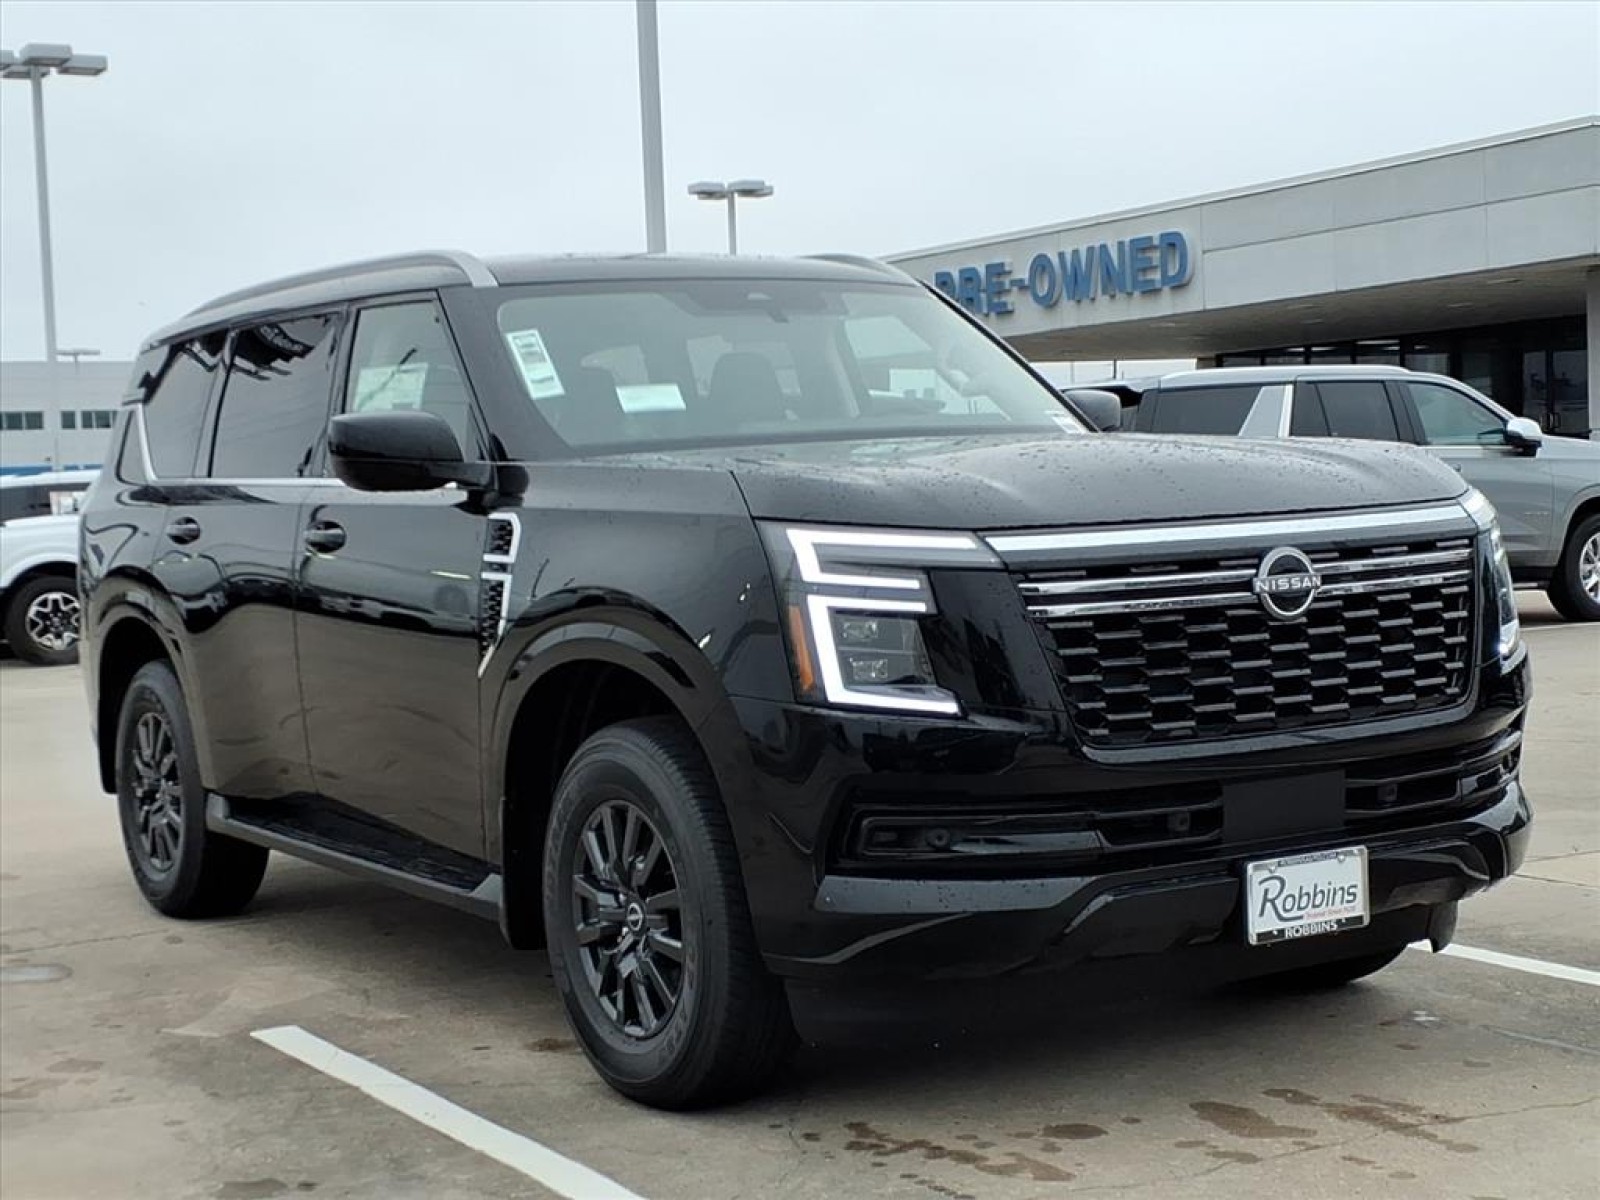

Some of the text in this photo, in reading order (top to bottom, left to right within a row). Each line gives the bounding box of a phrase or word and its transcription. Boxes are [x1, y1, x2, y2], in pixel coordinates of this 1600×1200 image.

[934, 231, 1191, 315] PRE-OWNED
[1254, 576, 1321, 593] NISSAN
[1258, 875, 1359, 922] Robbins
[1285, 920, 1338, 939] ROBBINS
